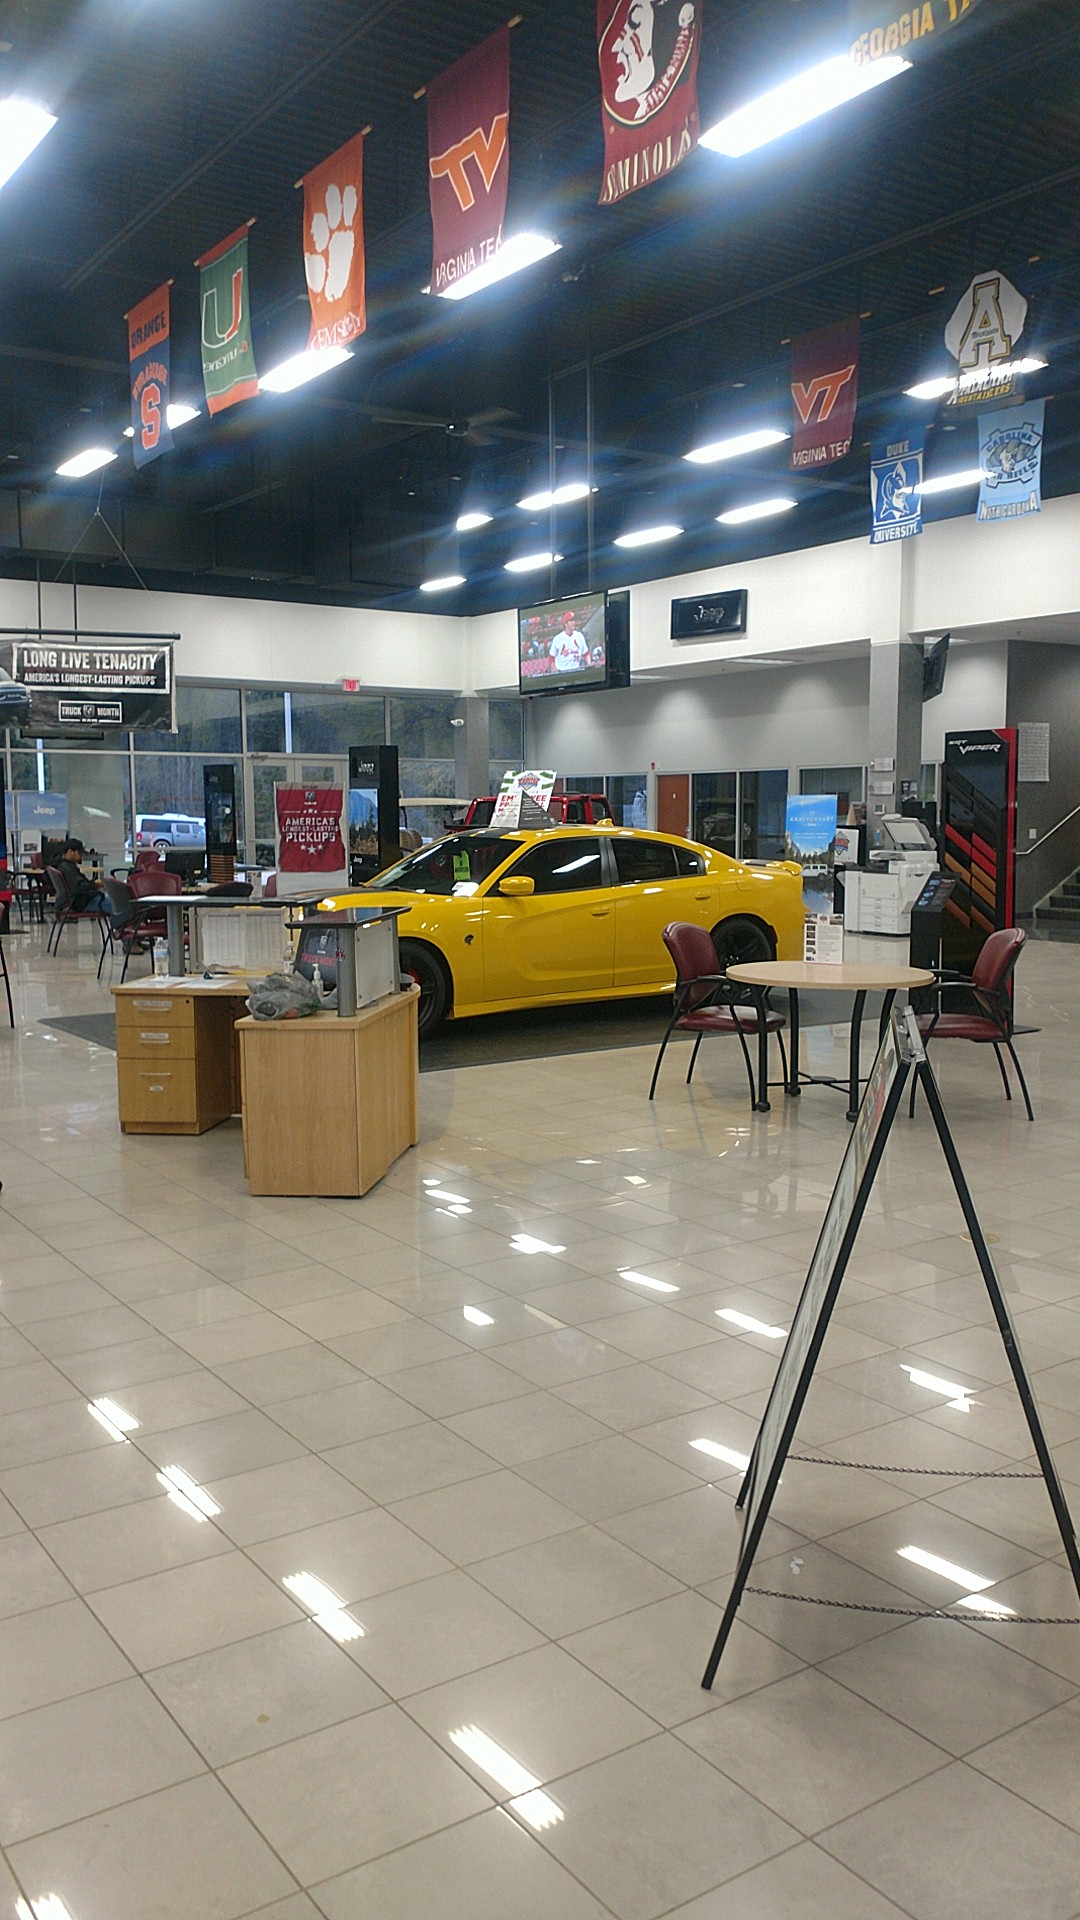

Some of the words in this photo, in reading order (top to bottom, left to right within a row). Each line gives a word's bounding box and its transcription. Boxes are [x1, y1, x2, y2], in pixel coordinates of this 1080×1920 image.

[850, 2, 935, 65] GEORGIA
[131, 310, 167, 349] ORANGE
[791, 365, 856, 424] VT
[141, 383, 161, 450] S
[886, 440, 909, 458] DUKE
[986, 431, 1033, 453] CAROLINA
[23, 650, 57, 668] LONG
[61, 651, 91, 669] LIVE
[93, 652, 158, 671] TENACITY
[24, 672, 60, 683] AMERICA'S
[61, 673, 124, 685] LONGEST-LASTING
[125, 675, 156, 686] PICKUPS
[61, 706, 82, 716] TRUCK
[97, 706, 120, 717] MONTH
[959, 743, 1001, 754] VIPER
[33, 805, 56, 816] Jeep
[286, 817, 335, 826] AMERICA'S
[286, 832, 336, 843] PICKUPS
